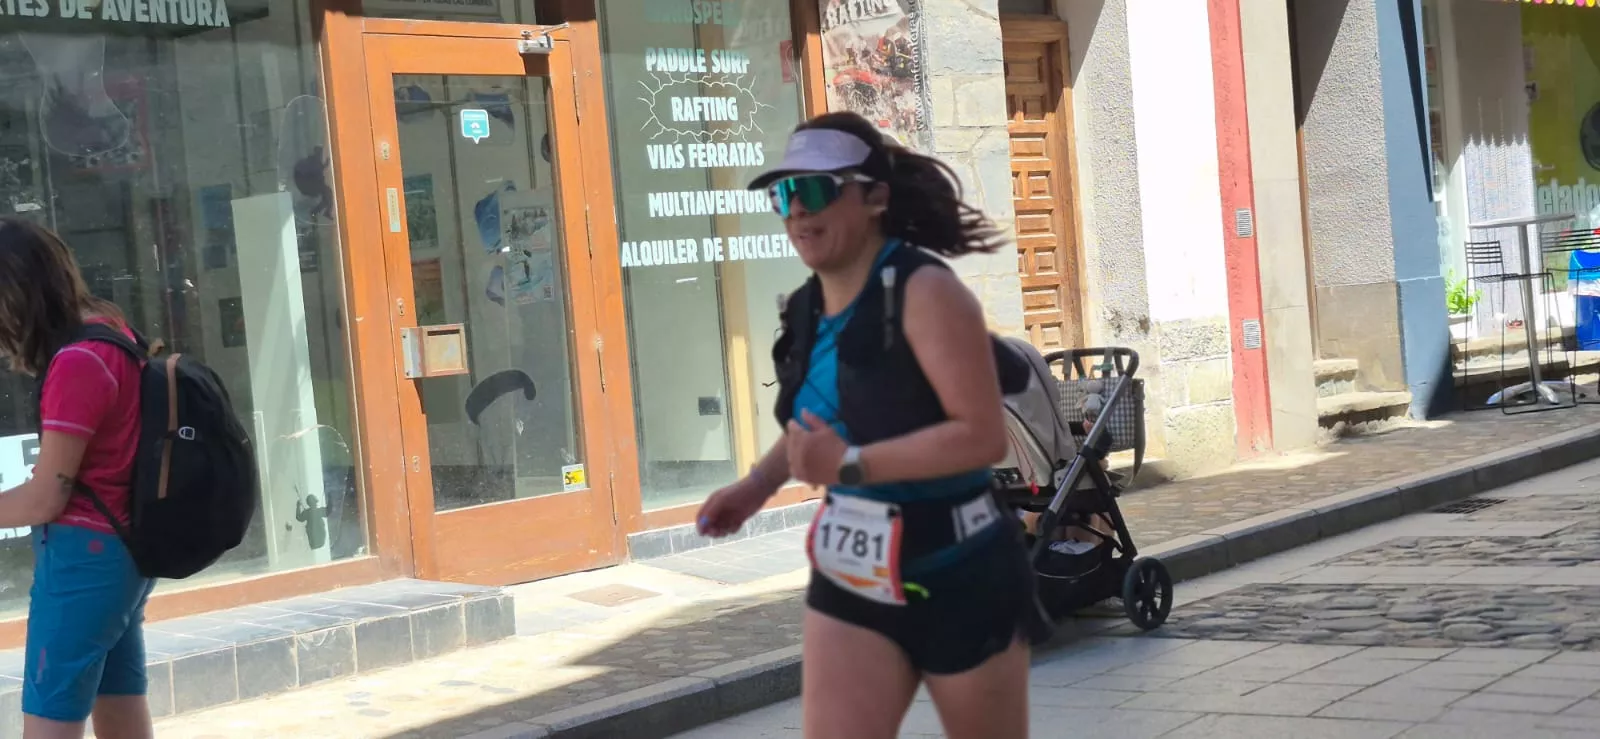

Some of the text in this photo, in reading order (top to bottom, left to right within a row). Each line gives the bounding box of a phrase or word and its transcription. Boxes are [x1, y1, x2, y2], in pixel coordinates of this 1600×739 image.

[0, 0, 230, 27] TES DE AVENTURA
[645, 47, 750, 74] PADDLE SURF
[671, 96, 738, 122] RAFTING
[646, 142, 765, 170] VIAS FERRATAS
[621, 238, 699, 267] ALQUILER
[702, 237, 724, 262] DE
[820, 521, 885, 562] 1781
